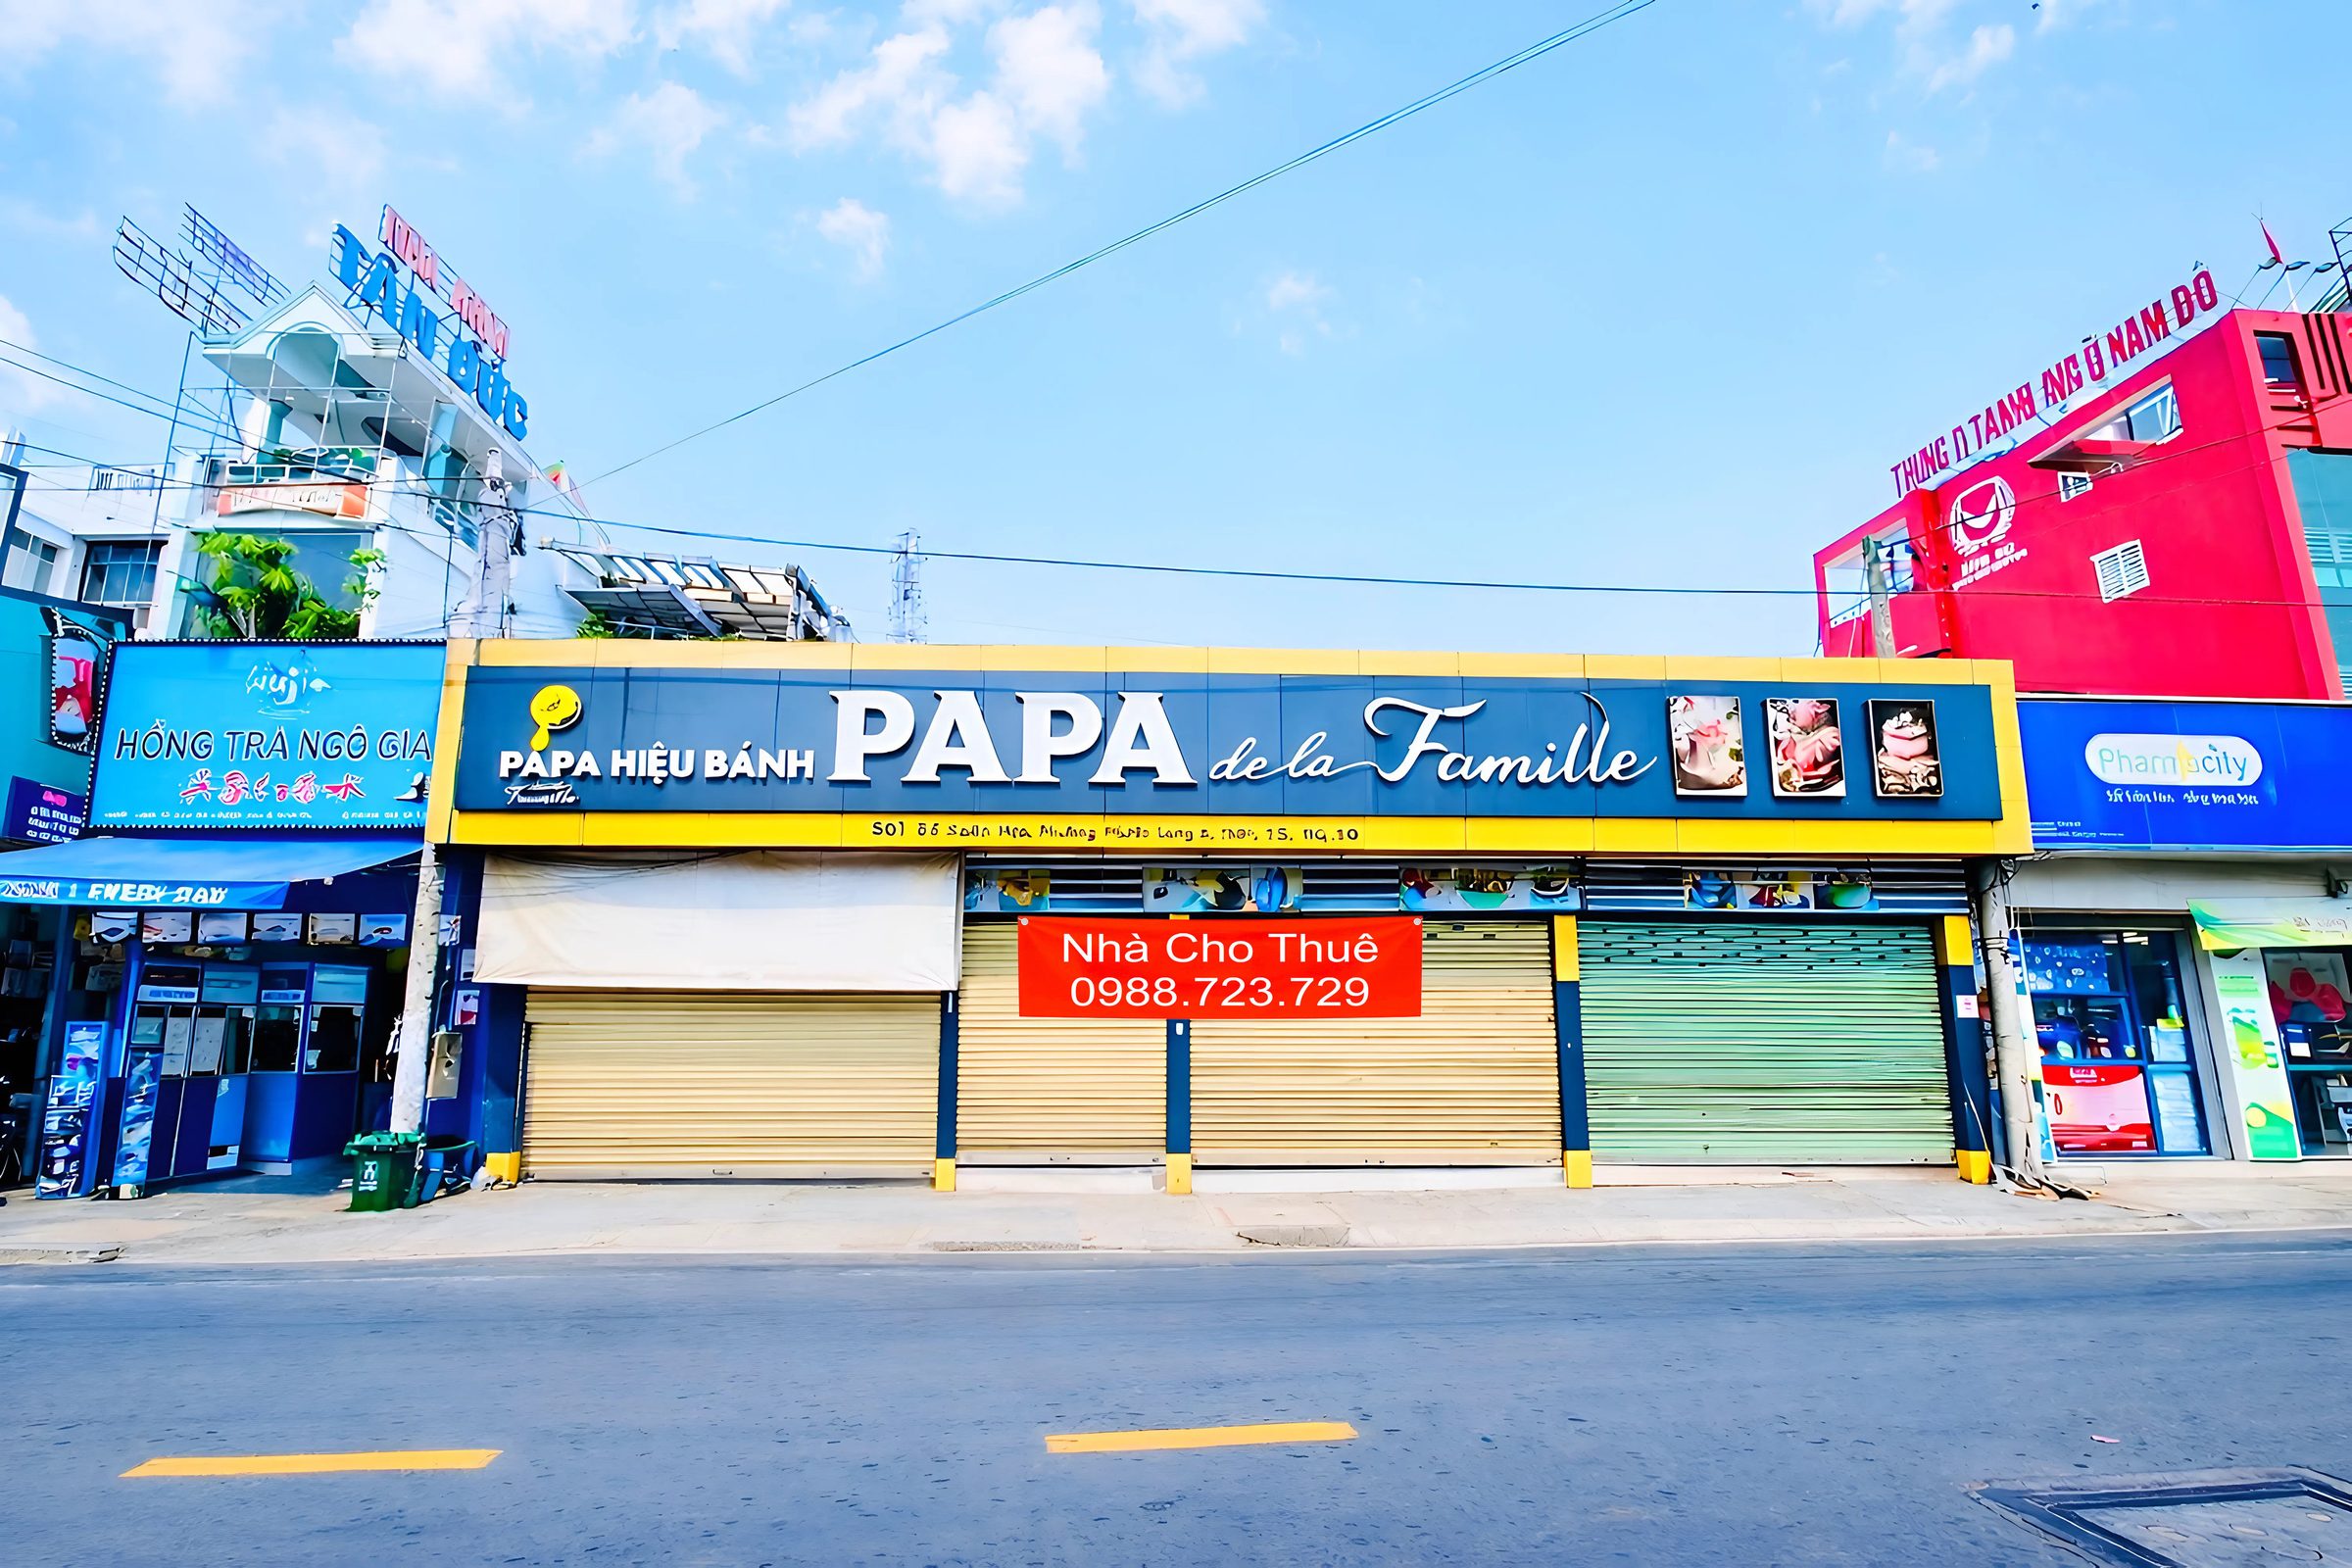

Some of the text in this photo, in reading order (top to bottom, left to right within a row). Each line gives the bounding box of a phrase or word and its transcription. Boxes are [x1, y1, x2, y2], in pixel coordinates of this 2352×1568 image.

[298, 724, 368, 761] NGÔ
[377, 729, 432, 761] GIA
[826, 690, 1657, 785] PAPA de la Famille
[499, 741, 815, 785] PAPA HIỆU BÁNH
[1063, 933, 1379, 963] Nhà Cho Thuê
[1070, 976, 1370, 1007] 0988.723.729
